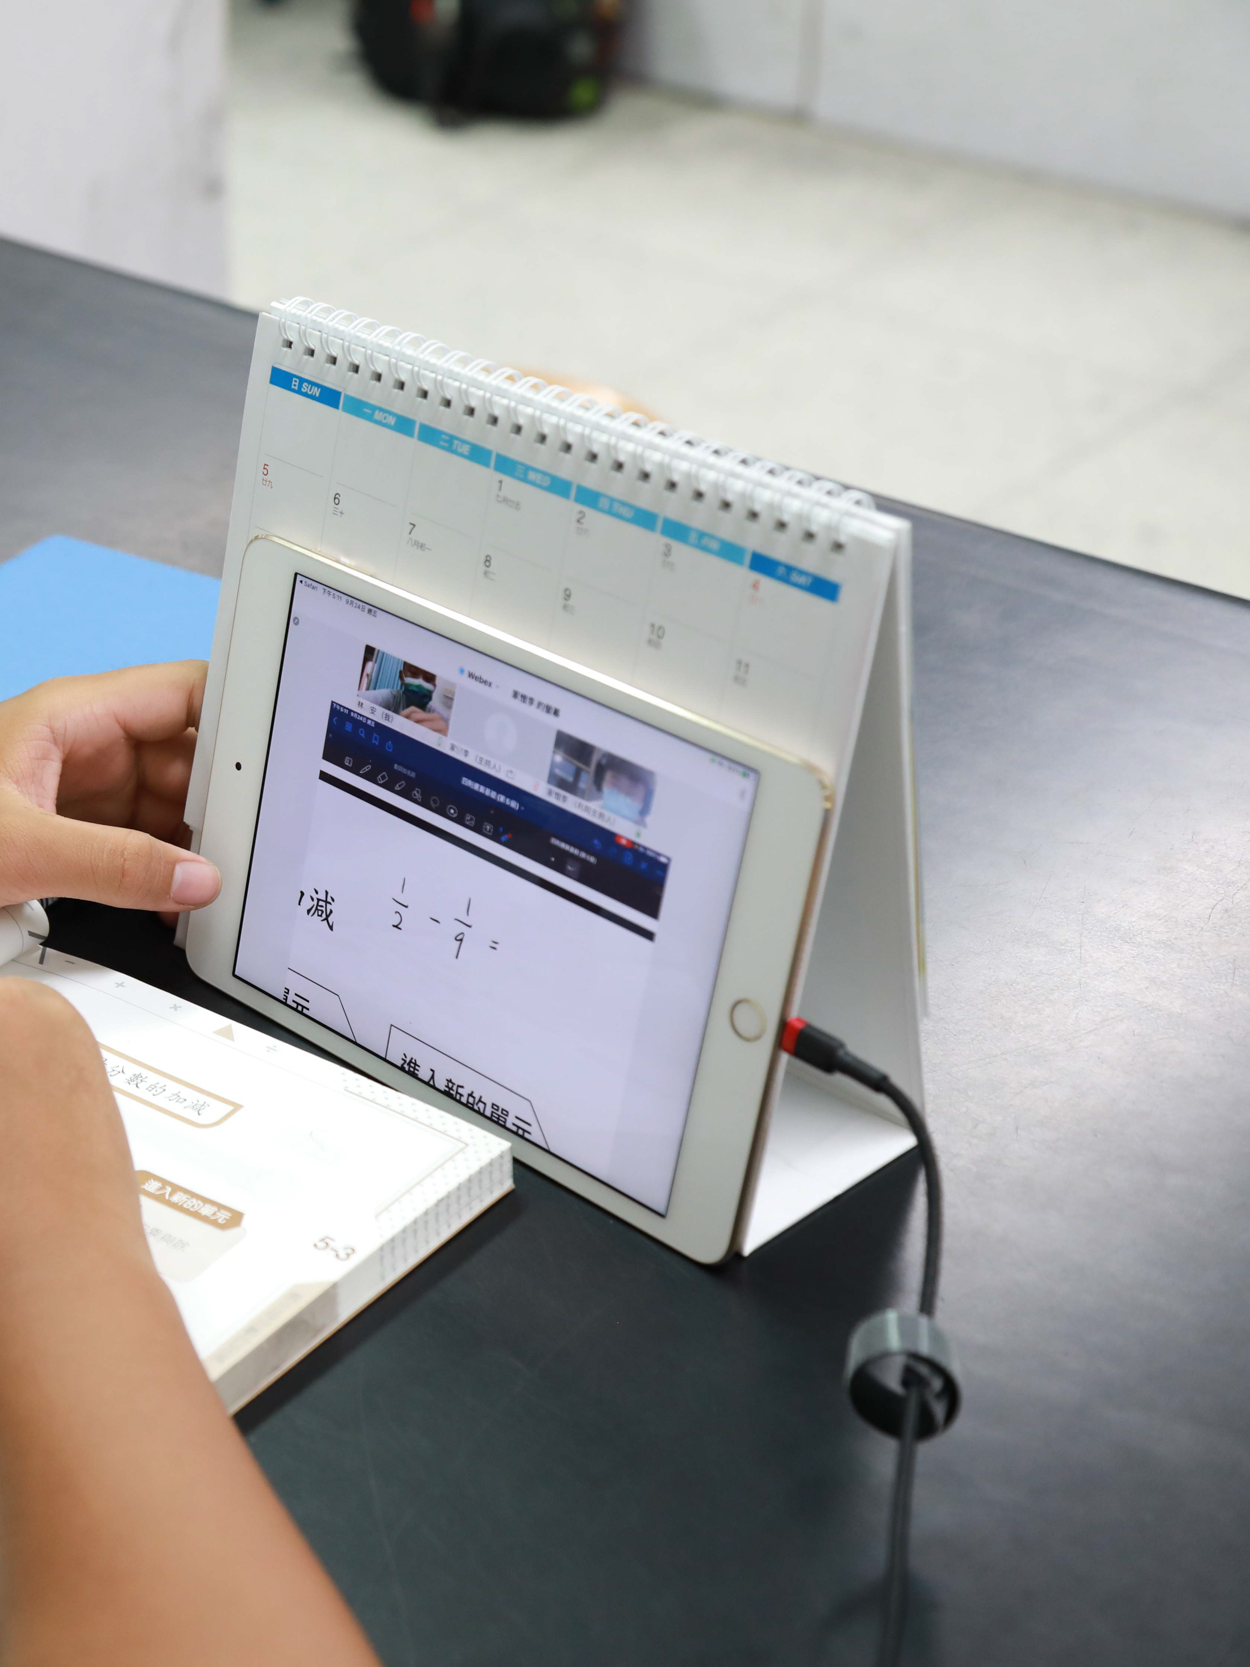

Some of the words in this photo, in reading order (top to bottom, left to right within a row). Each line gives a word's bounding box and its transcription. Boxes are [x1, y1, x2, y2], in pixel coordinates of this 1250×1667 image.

[291, 377, 300, 390] 日
[301, 381, 321, 398] SUN
[373, 410, 397, 426] MON
[452, 439, 472, 456] TUE
[261, 463, 270, 477] 5
[528, 467, 552, 488] WED
[498, 479, 504, 492] 1
[333, 492, 341, 506] 6
[576, 509, 586, 525] 2
[408, 522, 417, 536] 7
[483, 554, 492, 568] 8
[303, 580, 319, 592] Safari
[563, 587, 572, 602] 9
[649, 622, 666, 640] 10
[735, 658, 750, 675] 11
[467, 670, 493, 688] Webex
[140, 1177, 233, 1225] 進入新的單元
[313, 1235, 356, 1262] 5-3
